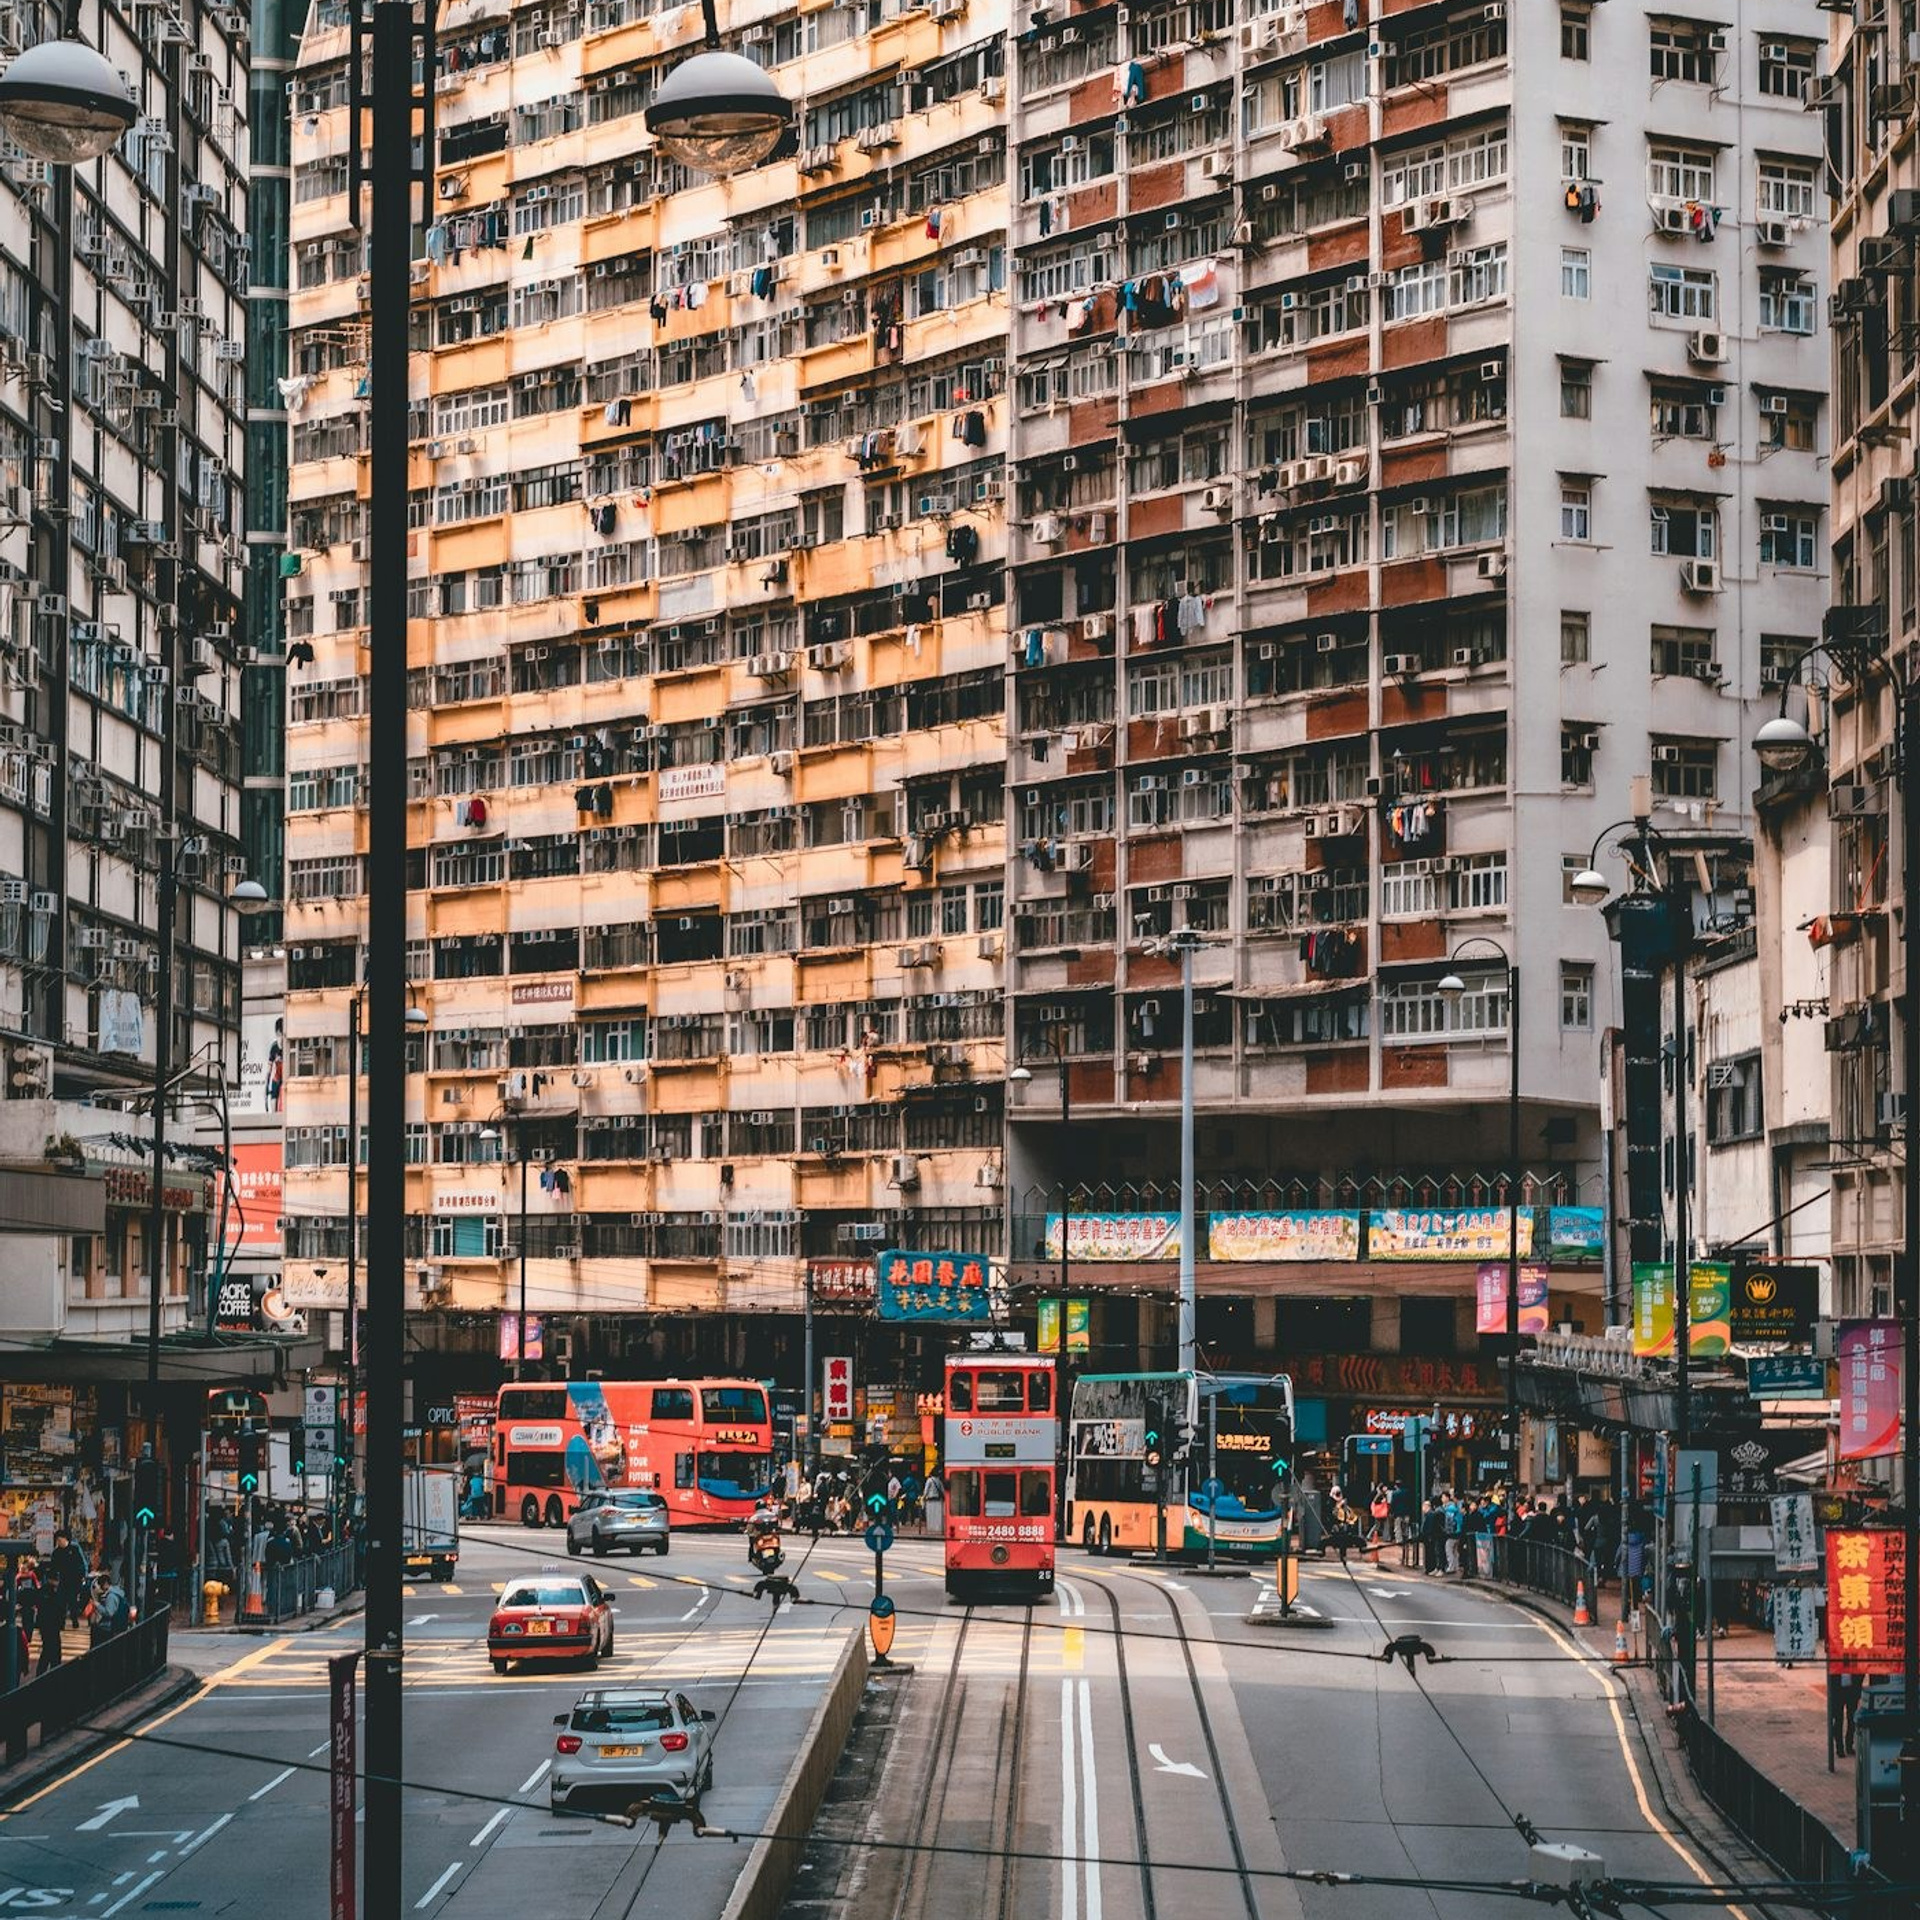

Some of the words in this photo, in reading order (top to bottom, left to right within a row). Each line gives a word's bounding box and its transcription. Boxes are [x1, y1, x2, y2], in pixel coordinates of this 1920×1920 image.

[219, 1300, 250, 1316] COFFEE
[1870, 1329, 1885, 1381] 第七屆
[629, 1439, 639, 1450] OF
[1254, 1436, 1271, 1451] 23
[629, 1457, 648, 1468] YOUR
[629, 1472, 653, 1483] FUTURE
[1018, 1525, 1045, 1536] 8888
[621, 1747, 638, 1755] 770
